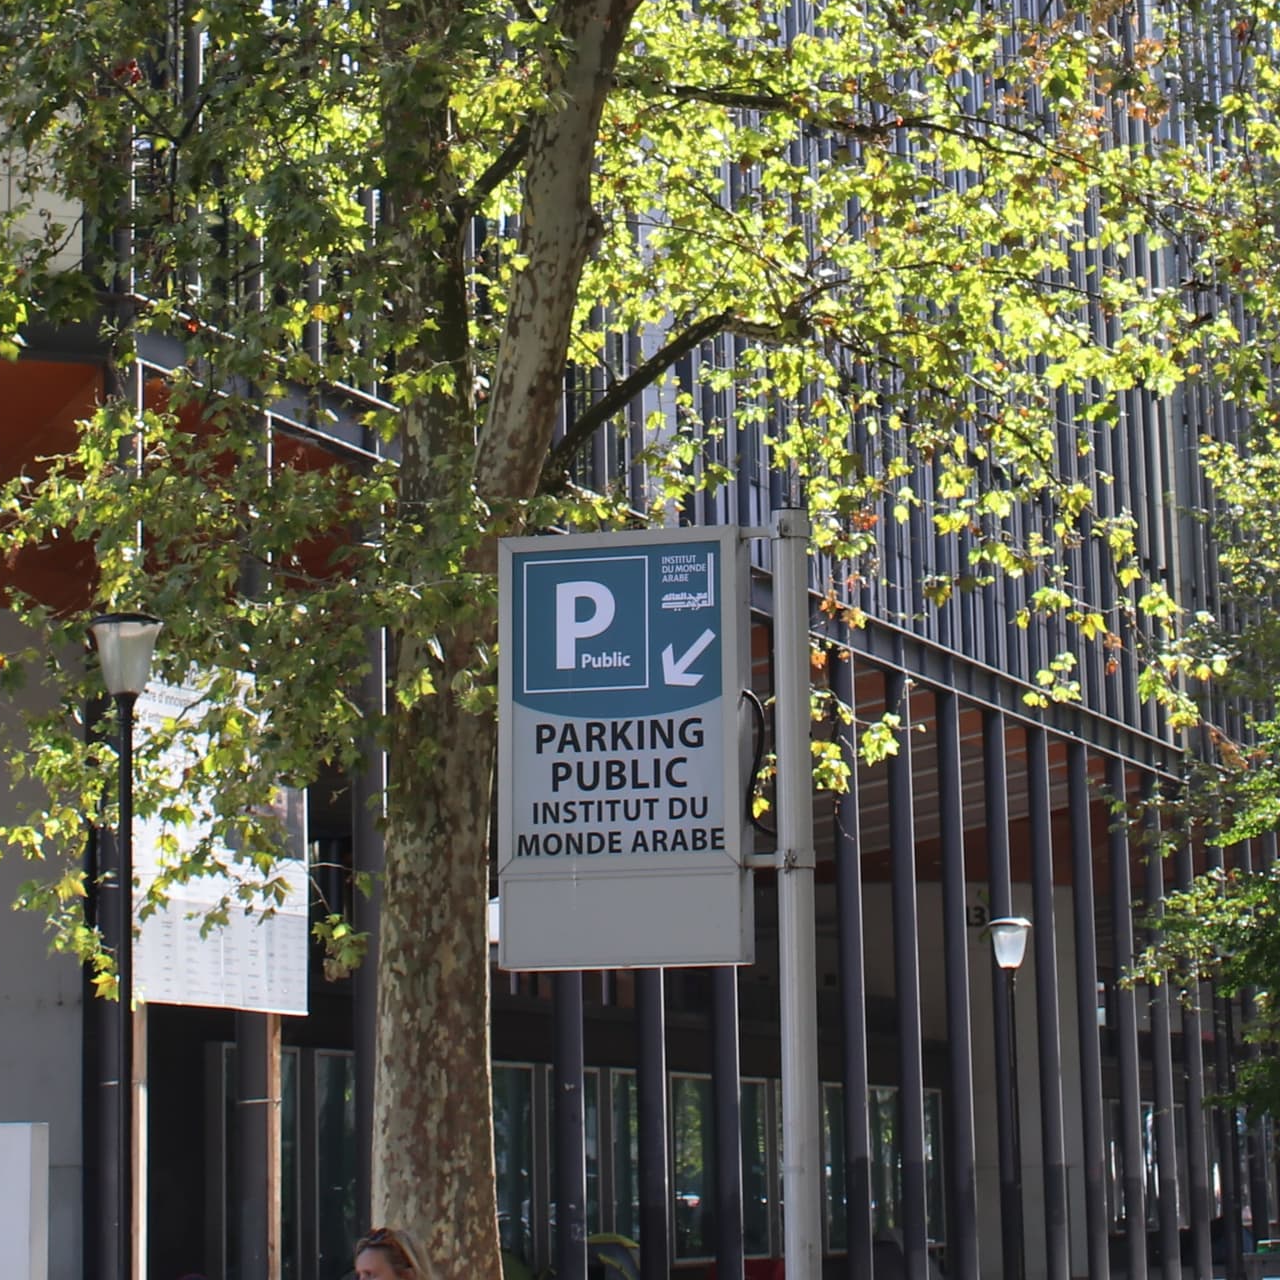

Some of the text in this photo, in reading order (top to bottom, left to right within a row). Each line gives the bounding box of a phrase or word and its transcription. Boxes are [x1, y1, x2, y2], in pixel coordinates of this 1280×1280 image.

[662, 554, 696, 565] INSTITUT
[662, 563, 707, 574] DU MONDE
[662, 573, 689, 583] ARABE
[556, 580, 616, 670] P
[581, 651, 631, 669] Public
[535, 717, 704, 754] PARKING
[551, 757, 688, 792] PUBLIC
[532, 796, 708, 824] INSTITUT DU
[518, 827, 725, 857] MONDE ARABE
